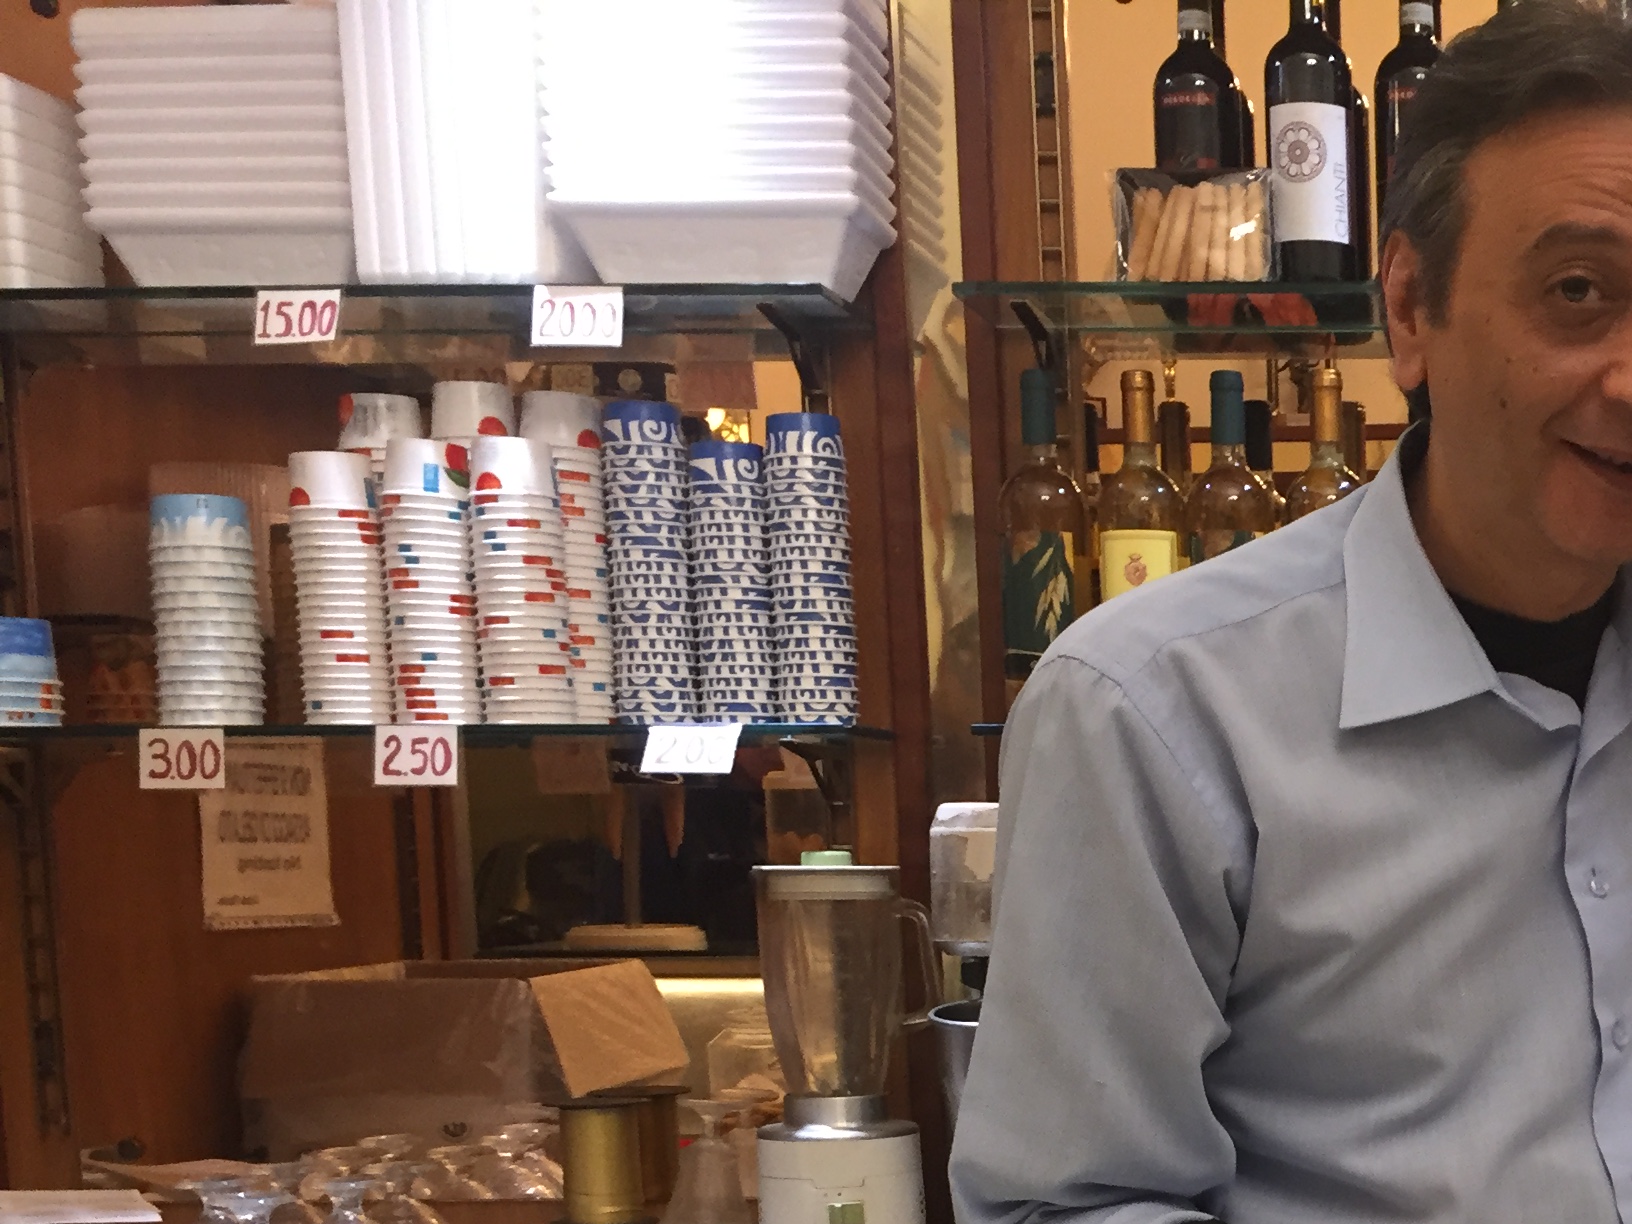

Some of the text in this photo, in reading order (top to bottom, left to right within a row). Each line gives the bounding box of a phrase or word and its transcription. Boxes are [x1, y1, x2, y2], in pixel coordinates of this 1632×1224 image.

[258, 299, 337, 338] 15.00
[148, 737, 221, 780] 3.00
[381, 734, 453, 777] 2.50
